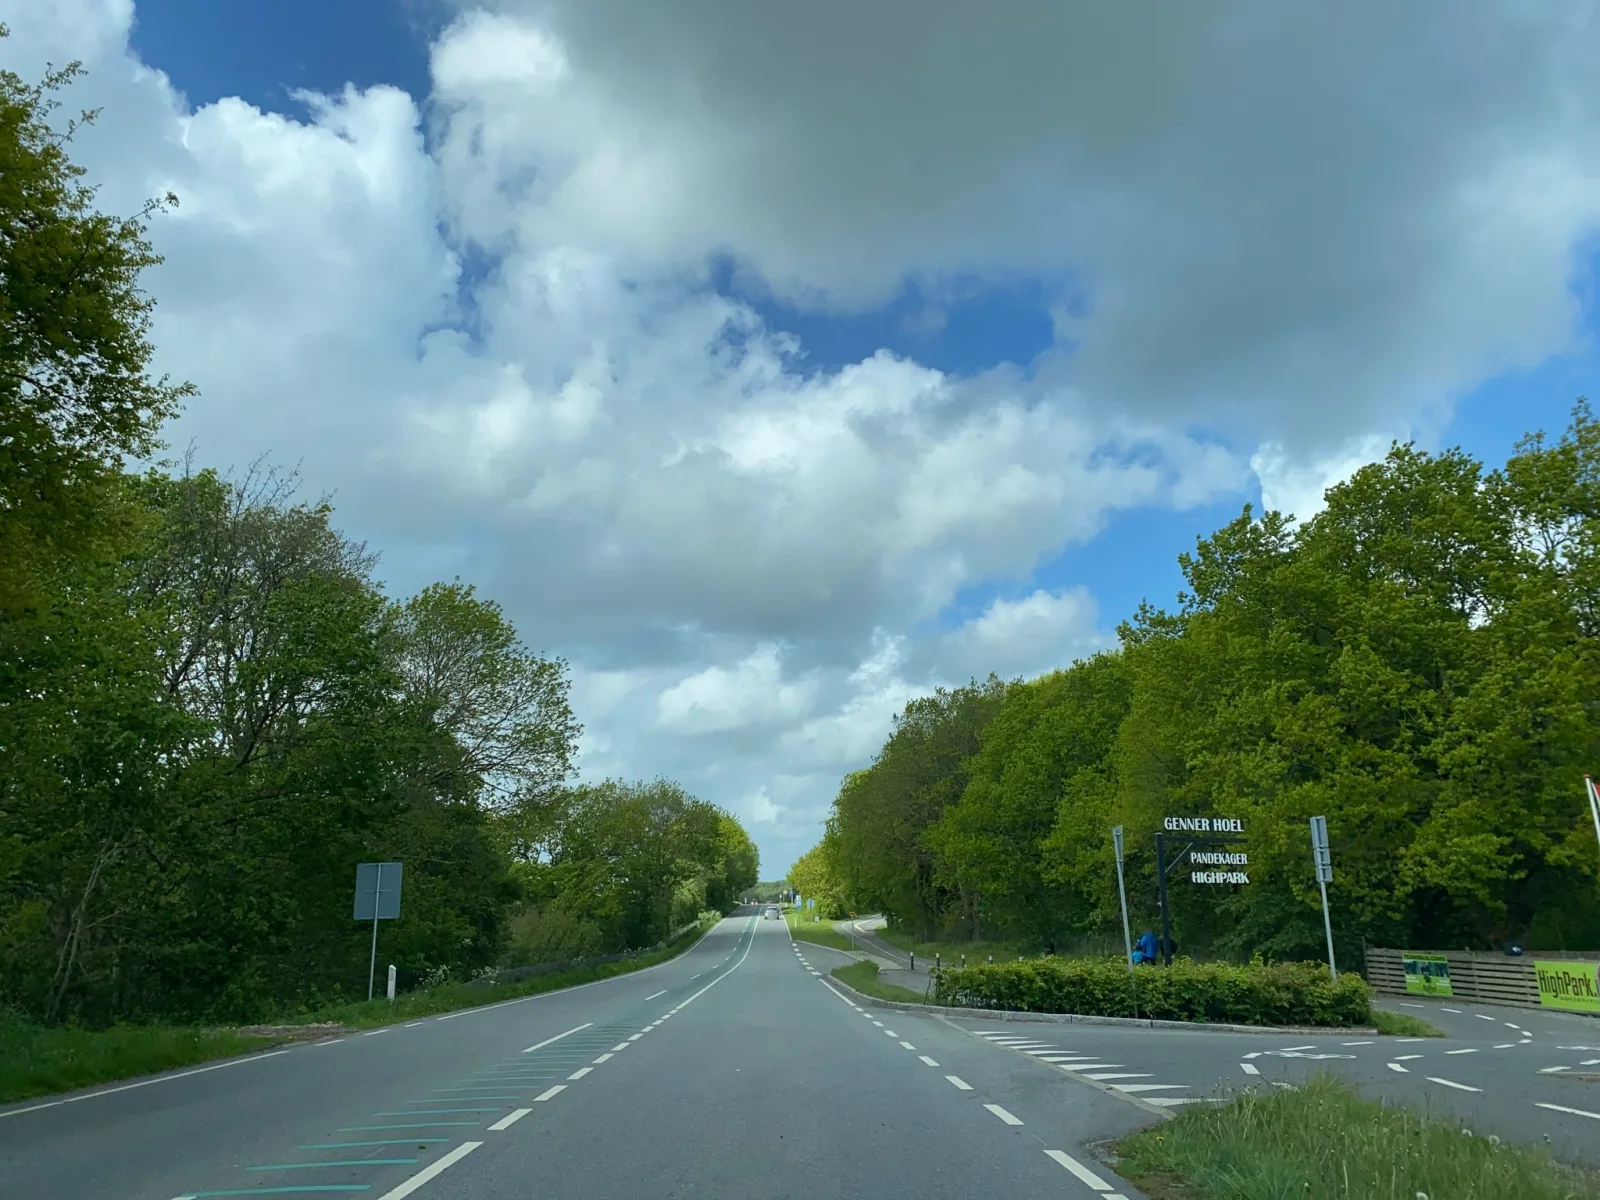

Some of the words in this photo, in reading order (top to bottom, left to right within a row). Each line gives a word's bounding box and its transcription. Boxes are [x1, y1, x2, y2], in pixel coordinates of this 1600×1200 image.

[1164, 817, 1210, 831] GENNER
[1213, 818, 1245, 832] HOEL
[1191, 852, 1248, 865] PANDEKAGER
[1192, 871, 1250, 884] HIGHPARK
